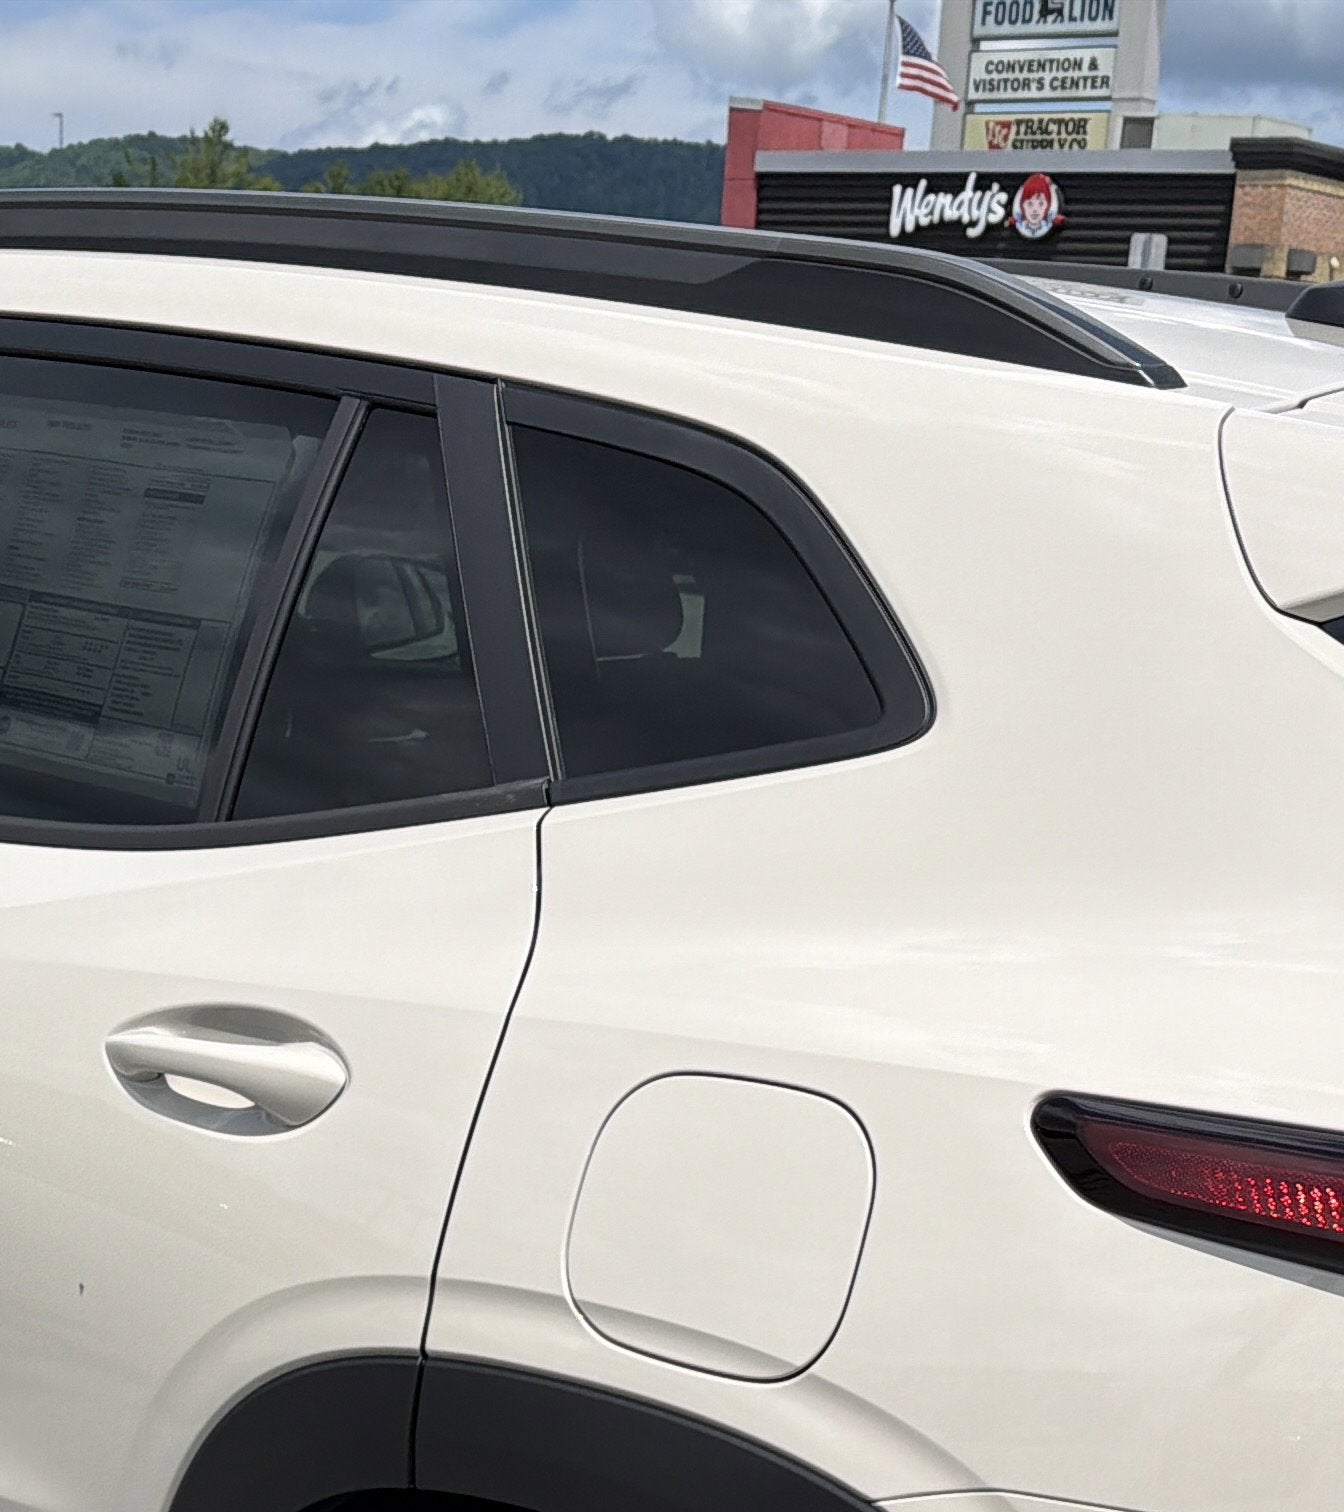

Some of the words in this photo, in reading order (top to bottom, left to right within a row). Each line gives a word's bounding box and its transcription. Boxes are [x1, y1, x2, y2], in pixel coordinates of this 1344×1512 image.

[980, 0, 1034, 26] FOOD
[1068, 0, 1116, 22] LION
[984, 56, 1084, 75] CONVENTION
[1088, 56, 1099, 71] &
[972, 77, 1045, 93] VISITOR'S
[1049, 75, 1112, 91] CENTER
[1014, 117, 1089, 136] TRACTOR
[889, 171, 1009, 239] Wendy's
